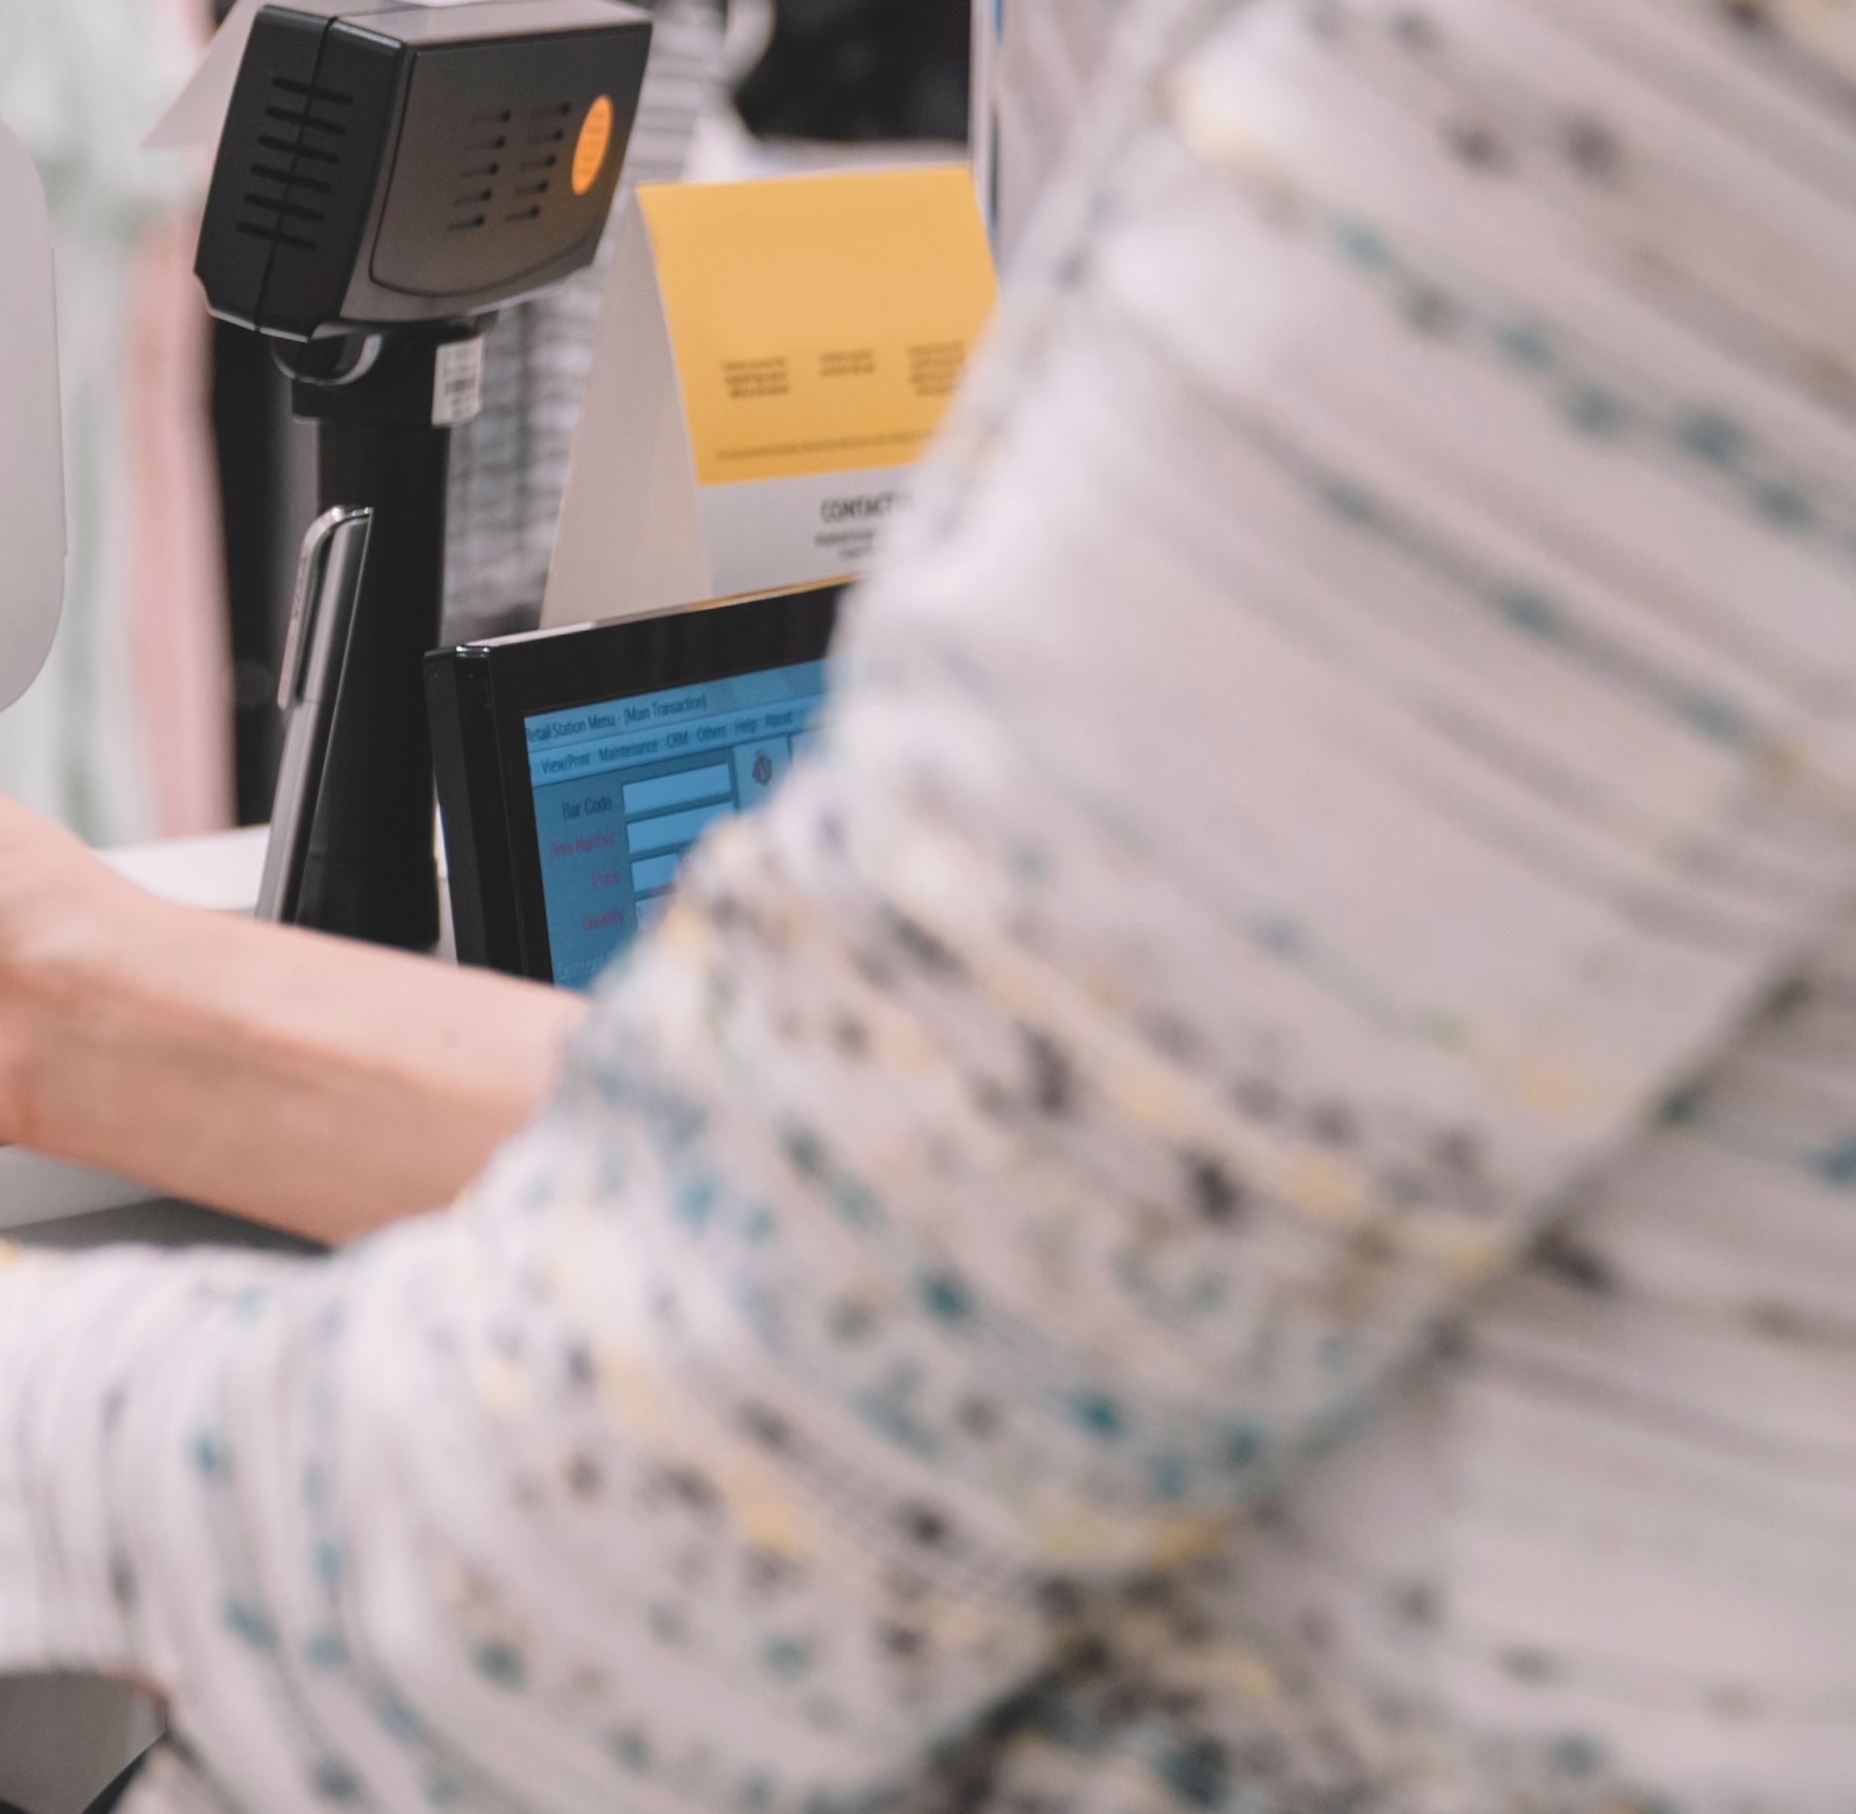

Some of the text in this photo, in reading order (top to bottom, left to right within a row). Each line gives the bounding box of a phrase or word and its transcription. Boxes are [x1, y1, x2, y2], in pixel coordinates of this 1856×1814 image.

[553, 719, 586, 738] Station
[588, 713, 615, 730] Menu
[599, 740, 658, 763] Maintenance
[666, 729, 689, 749] CRM
[697, 725, 727, 743] Others
[562, 796, 613, 820] Bar Code
